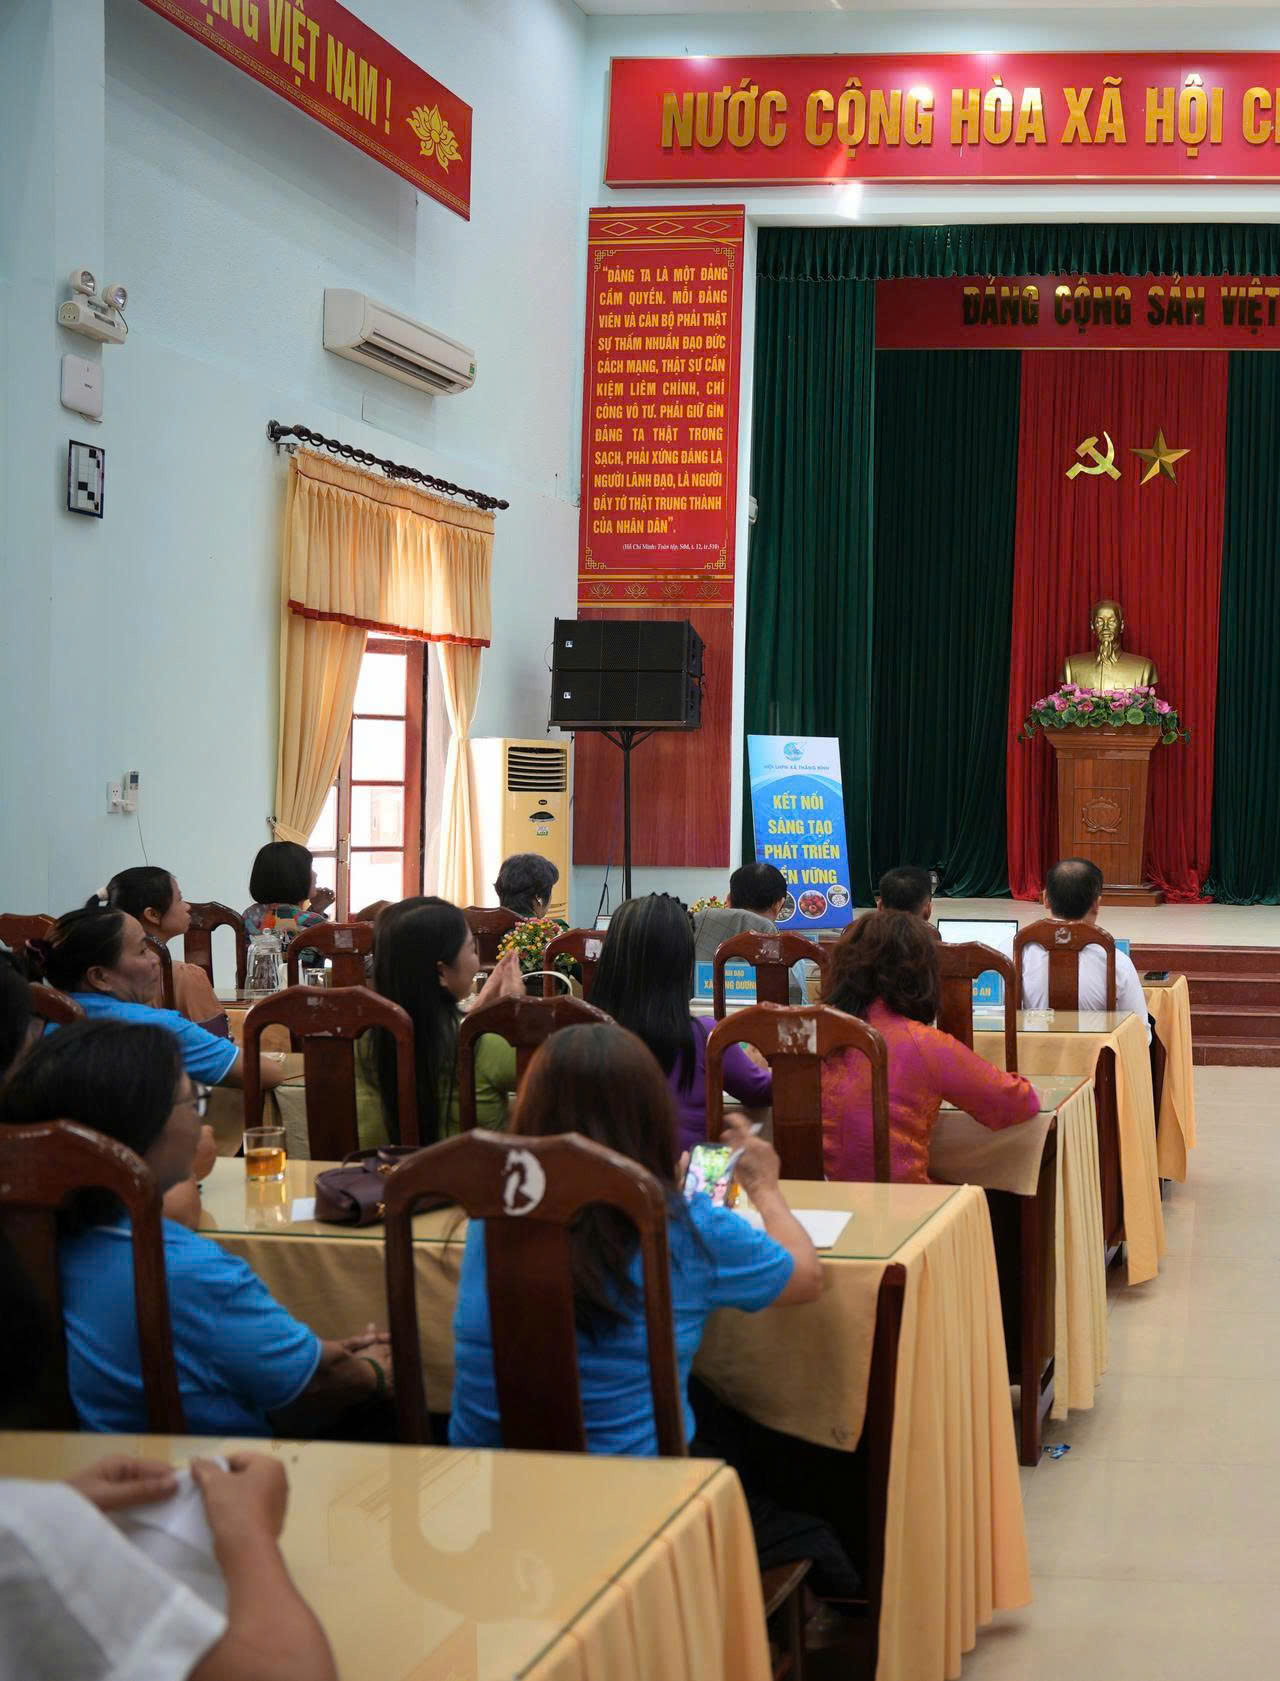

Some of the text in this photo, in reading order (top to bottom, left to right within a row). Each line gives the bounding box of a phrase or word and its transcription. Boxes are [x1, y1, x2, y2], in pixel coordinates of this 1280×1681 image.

[268, 0, 319, 86] VIỆT
[326, 33, 377, 126] NAM
[385, 78, 391, 135] !
[661, 77, 788, 149] NƯỚC
[804, 76, 933, 158] CỘNG
[951, 73, 1047, 145] HÒA
[1061, 77, 1127, 144] XÃ
[1145, 73, 1224, 157] HỘI
[640, 269, 650, 281] TA
[657, 266, 668, 281] LÀ
[674, 266, 695, 284] MỘT
[701, 263, 728, 281] ĐẢNG
[600, 286, 727, 306] CẦM QUYỀN. MỖI ĐẢNG
[963, 273, 1039, 325] ĐẢNG
[1054, 277, 1131, 334] CỘNG
[1148, 273, 1205, 325] SẢN
[1221, 277, 1280, 334] VIỆT
[599, 309, 727, 329] VIÊN VÀ CÁN BỘ PHẢI THẬT
[598, 332, 726, 353] SỰ THẤM NHUẦN ĐẠO ĐỨC
[773, 790, 824, 810] KẾT NỐI
[768, 817, 833, 838] SÁNG TẠO
[764, 840, 840, 859] PHÁT TRIỂN
[781, 865, 838, 884] ỀN VỮNG
